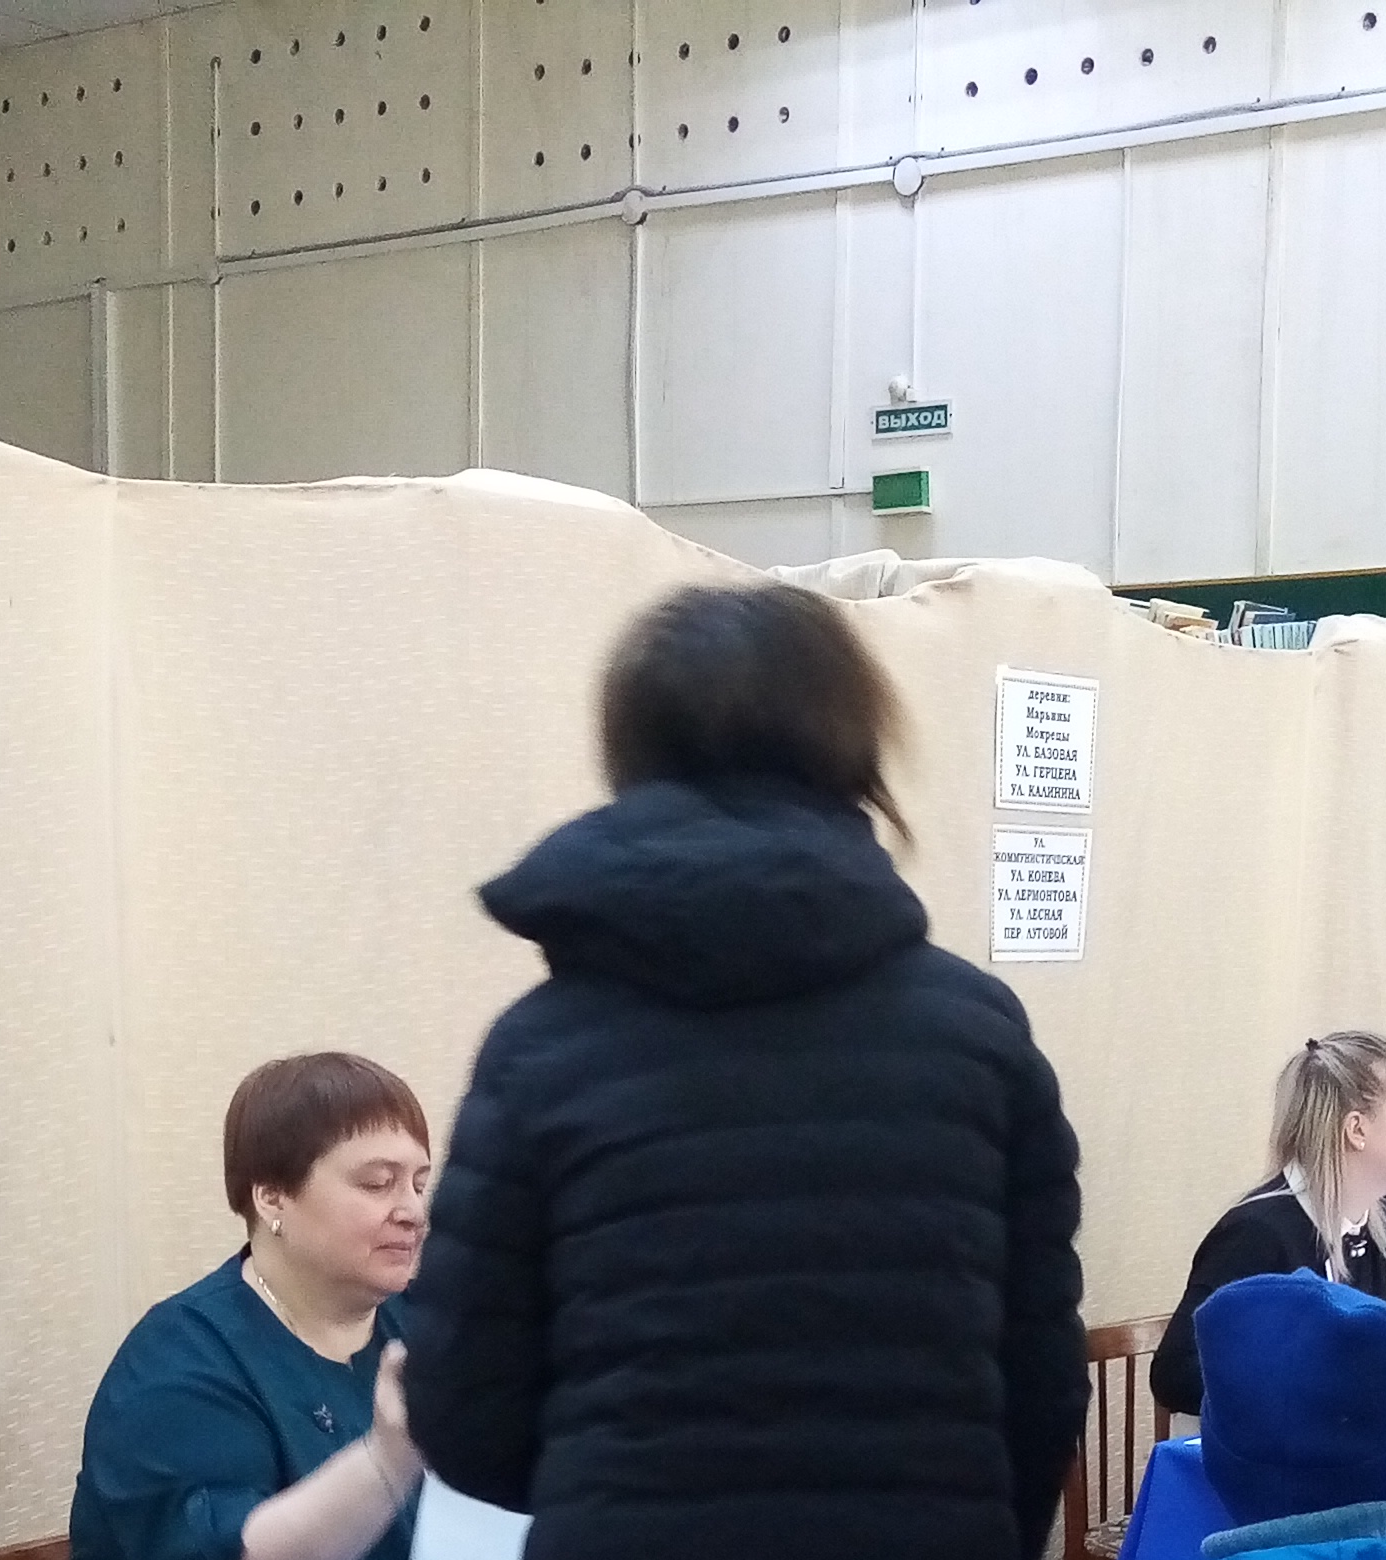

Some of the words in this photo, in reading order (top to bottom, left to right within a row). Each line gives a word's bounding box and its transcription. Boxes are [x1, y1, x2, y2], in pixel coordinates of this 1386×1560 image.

[877, 410, 946, 430] ВЫХОД
[1026, 706, 1071, 723] Марьины
[1026, 726, 1070, 743] Мокрецы
[1016, 744, 1031, 758] УЛ.
[1034, 746, 1078, 762] БАЗОВАЯ
[1015, 764, 1030, 777] УЛ.
[1033, 766, 1077, 781] ГЕРЦЕНА
[1011, 783, 1025, 796] УЛ.
[1028, 784, 1081, 800] КАЛИНИНА
[1011, 869, 1024, 881] УЛ.
[1028, 870, 1065, 883] КОНЕВА
[998, 888, 1011, 901] УЛ.
[1014, 889, 1077, 902] ЛЕРМОНТОВА
[1010, 907, 1023, 920] УЛ.
[1026, 908, 1063, 921] ЛЕСНАЯ
